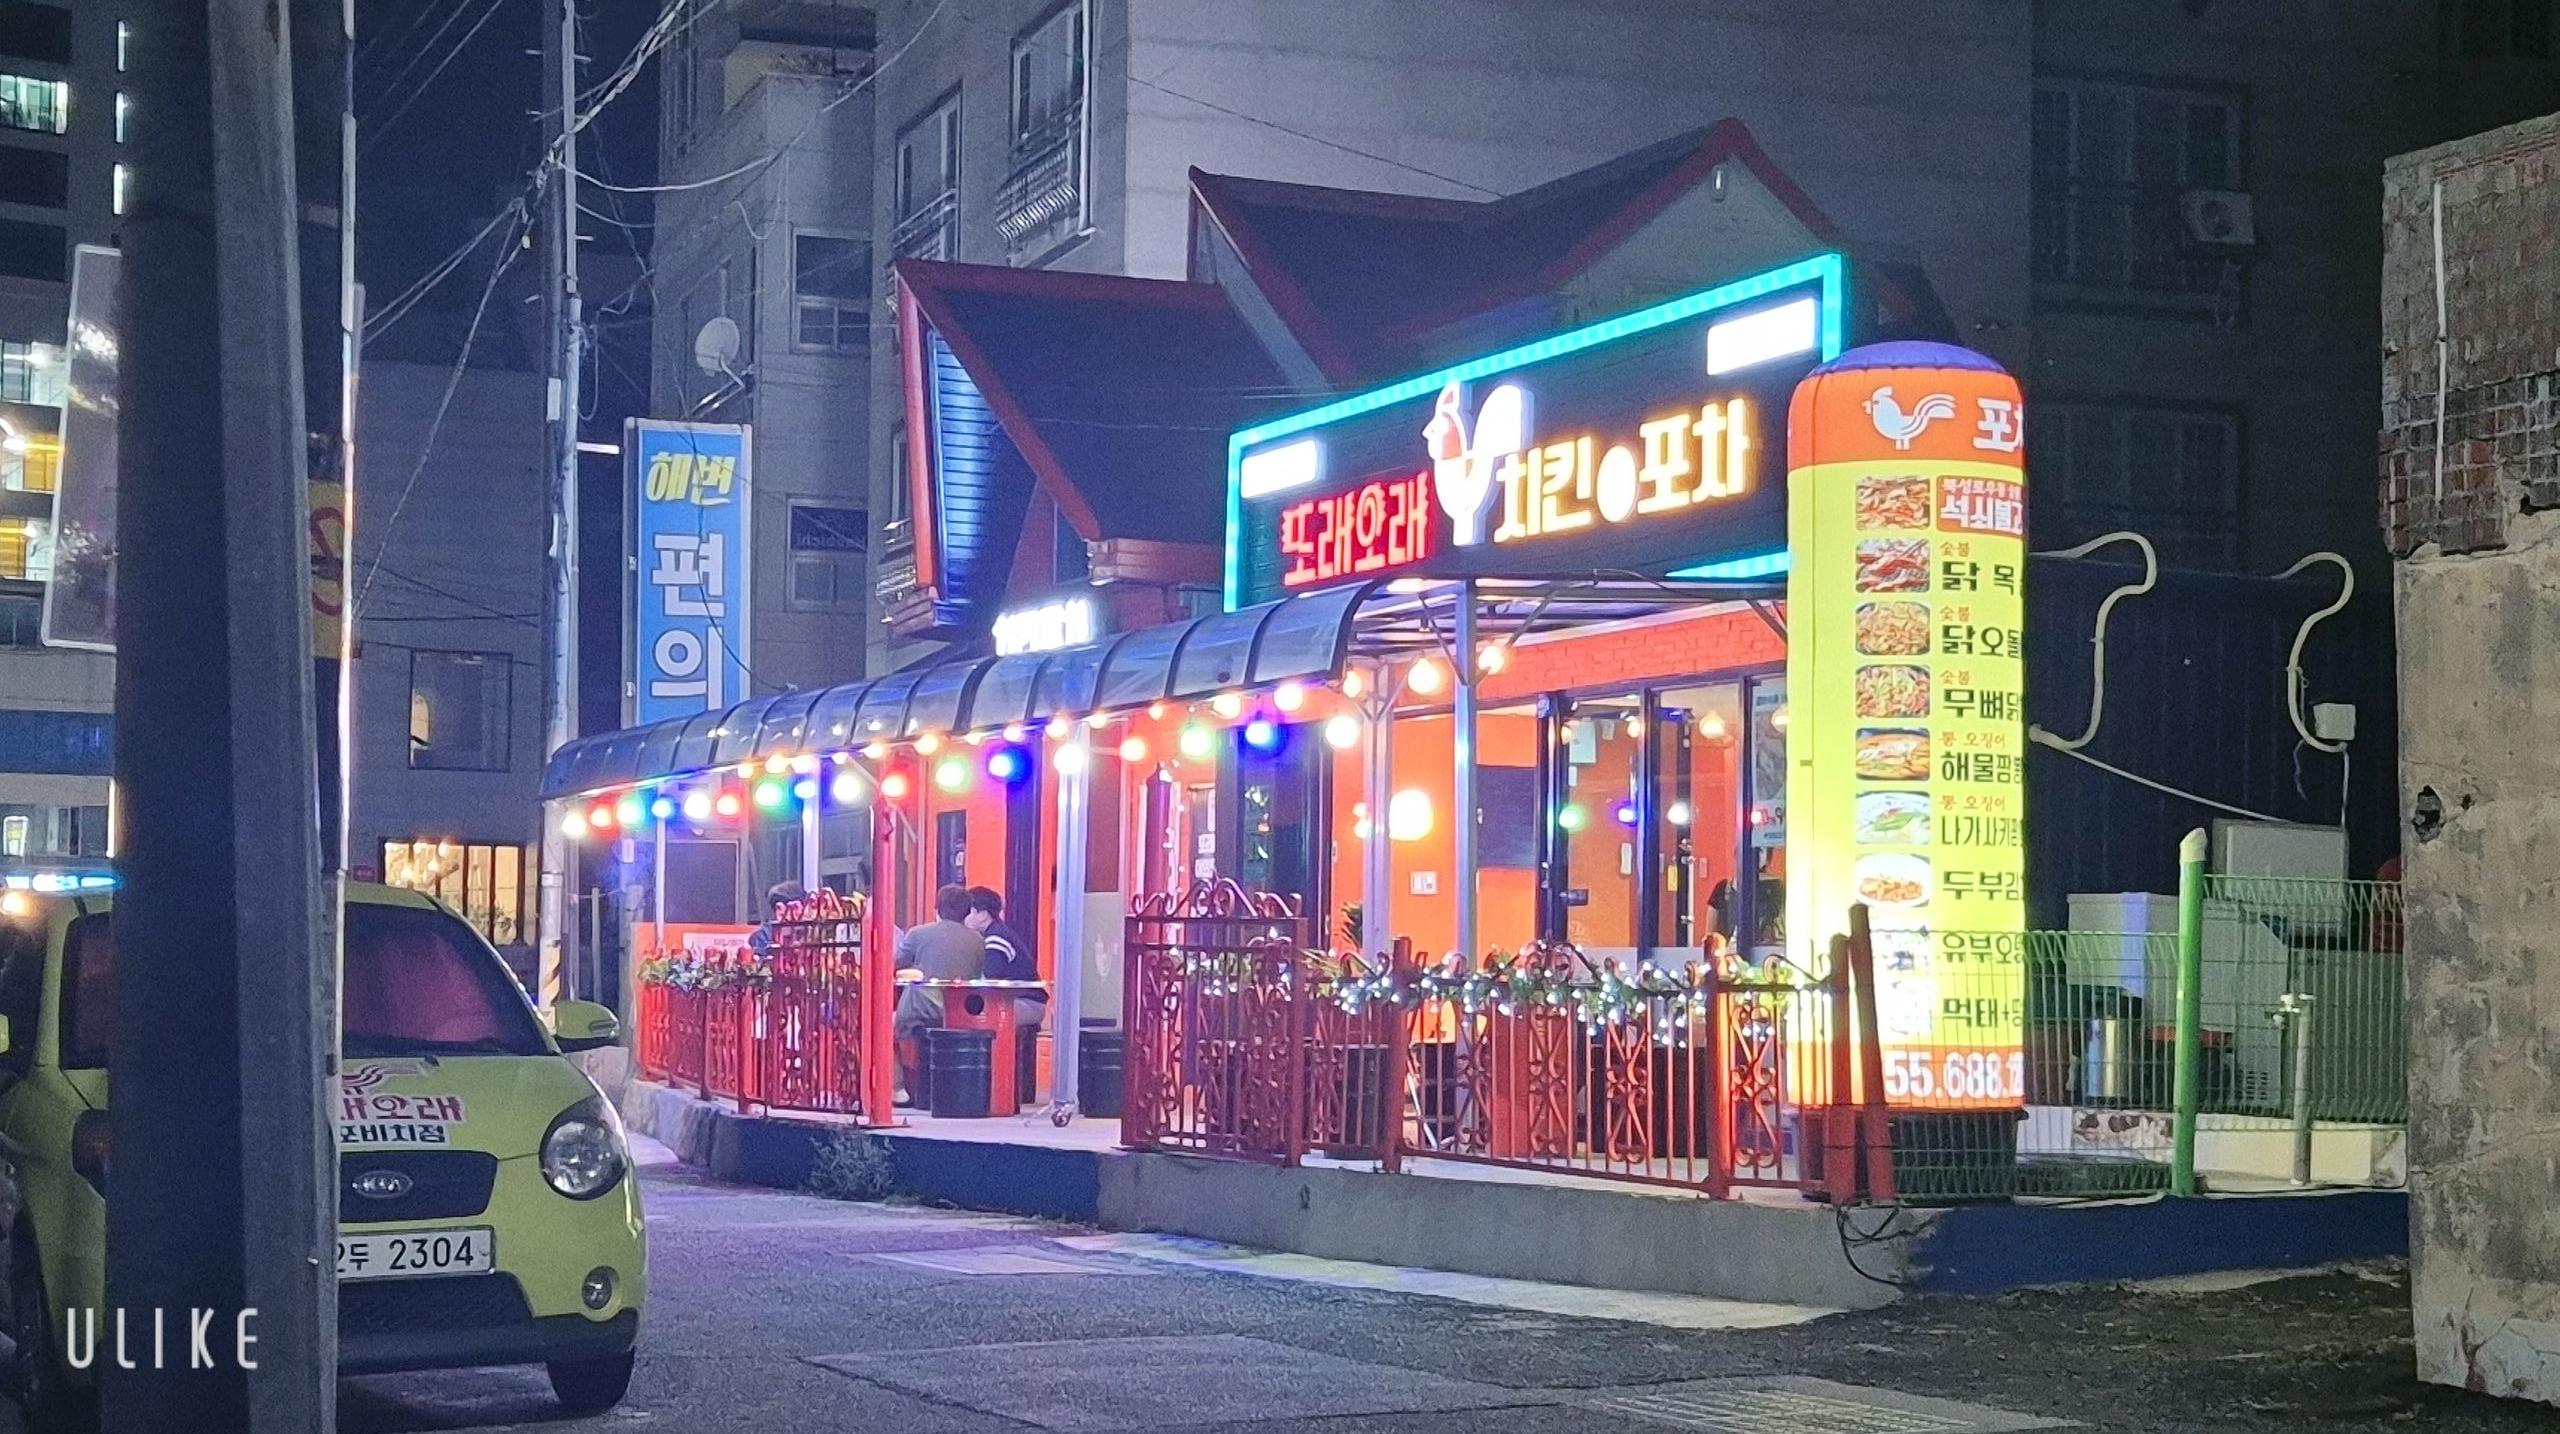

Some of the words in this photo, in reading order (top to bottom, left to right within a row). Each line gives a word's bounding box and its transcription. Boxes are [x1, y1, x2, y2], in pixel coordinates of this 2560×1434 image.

[644, 449, 737, 507] 해변
[1281, 470, 1430, 587] 또래오래
[1493, 434, 1594, 544] 치킨
[1637, 398, 1752, 515] 포차
[650, 531, 727, 712] 편의
[388, 1235, 475, 1271] 2304
